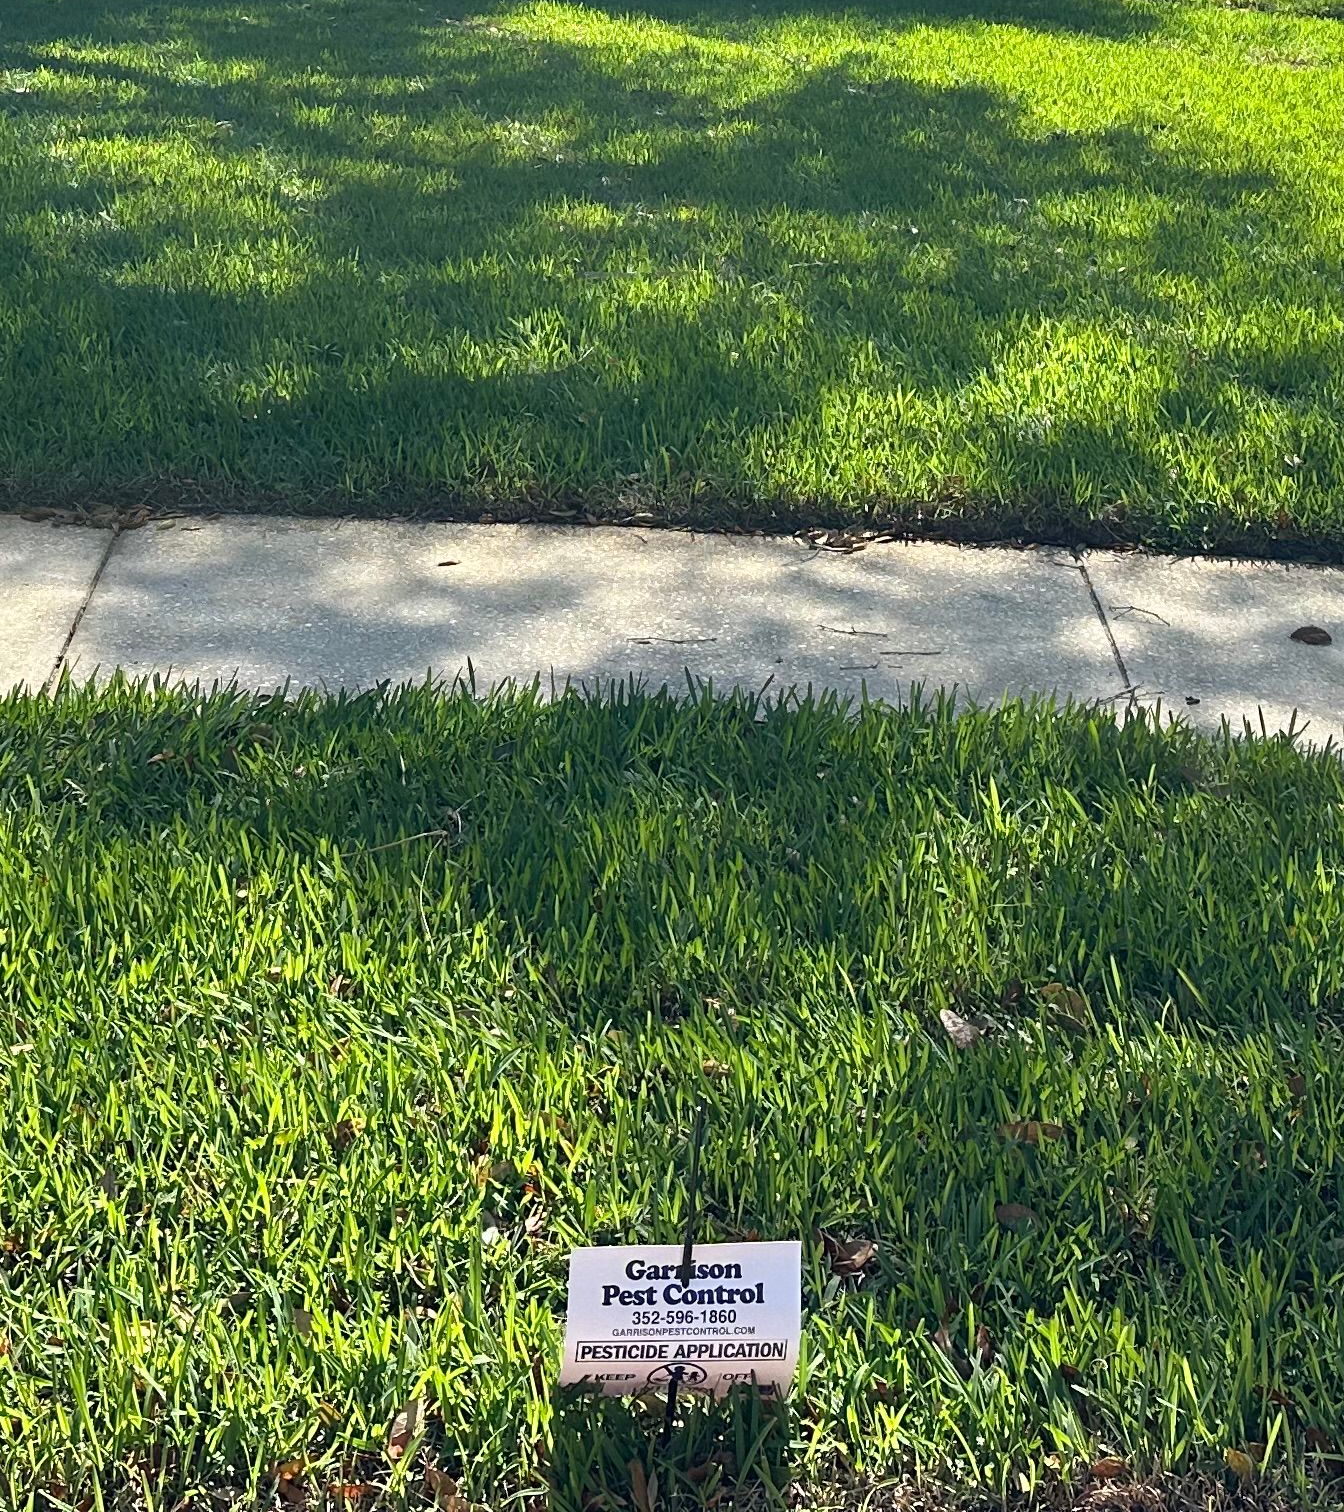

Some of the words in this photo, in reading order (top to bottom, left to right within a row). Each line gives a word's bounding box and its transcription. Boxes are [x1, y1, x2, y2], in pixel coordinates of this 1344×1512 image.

[601, 1285, 657, 1306] Pest
[662, 1282, 765, 1305] Control
[631, 1309, 737, 1325] 352-596-1860
[612, 1326, 756, 1337] GARRISONPESTCONTROL.COM
[581, 1344, 669, 1360] PESTICIDE
[673, 1342, 784, 1359] APPLICATION
[594, 1373, 637, 1381] KEEP
